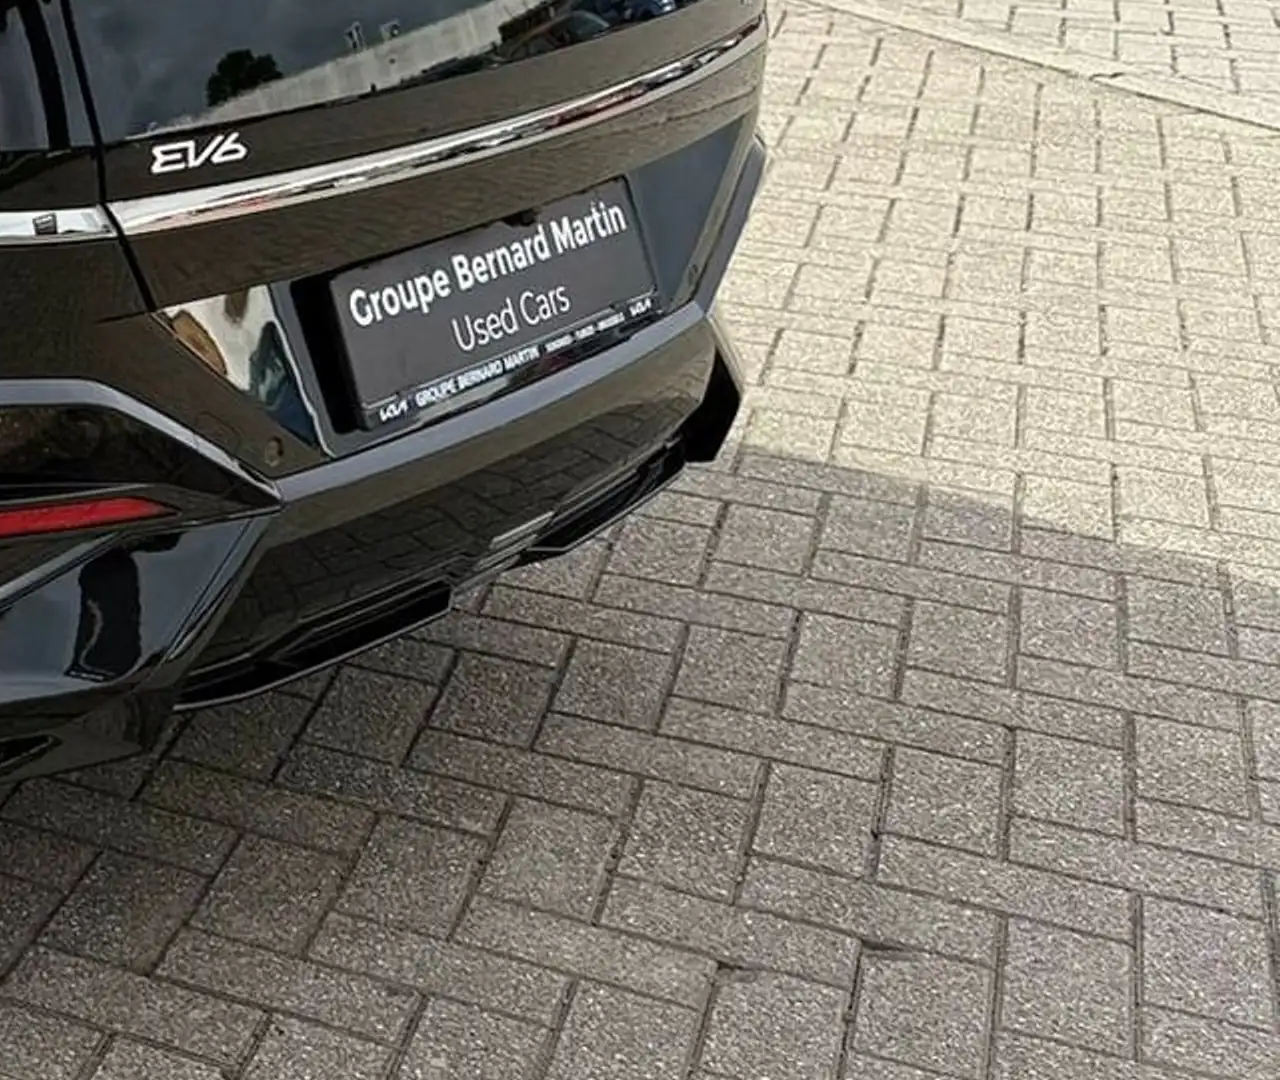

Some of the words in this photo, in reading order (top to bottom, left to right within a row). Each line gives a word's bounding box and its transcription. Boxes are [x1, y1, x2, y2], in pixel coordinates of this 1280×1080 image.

[150, 131, 248, 175] EV6
[349, 268, 451, 326] Groupe
[451, 226, 550, 291] Bernard
[549, 201, 628, 254] Martin
[450, 298, 519, 352] Used
[519, 285, 570, 326] Cars
